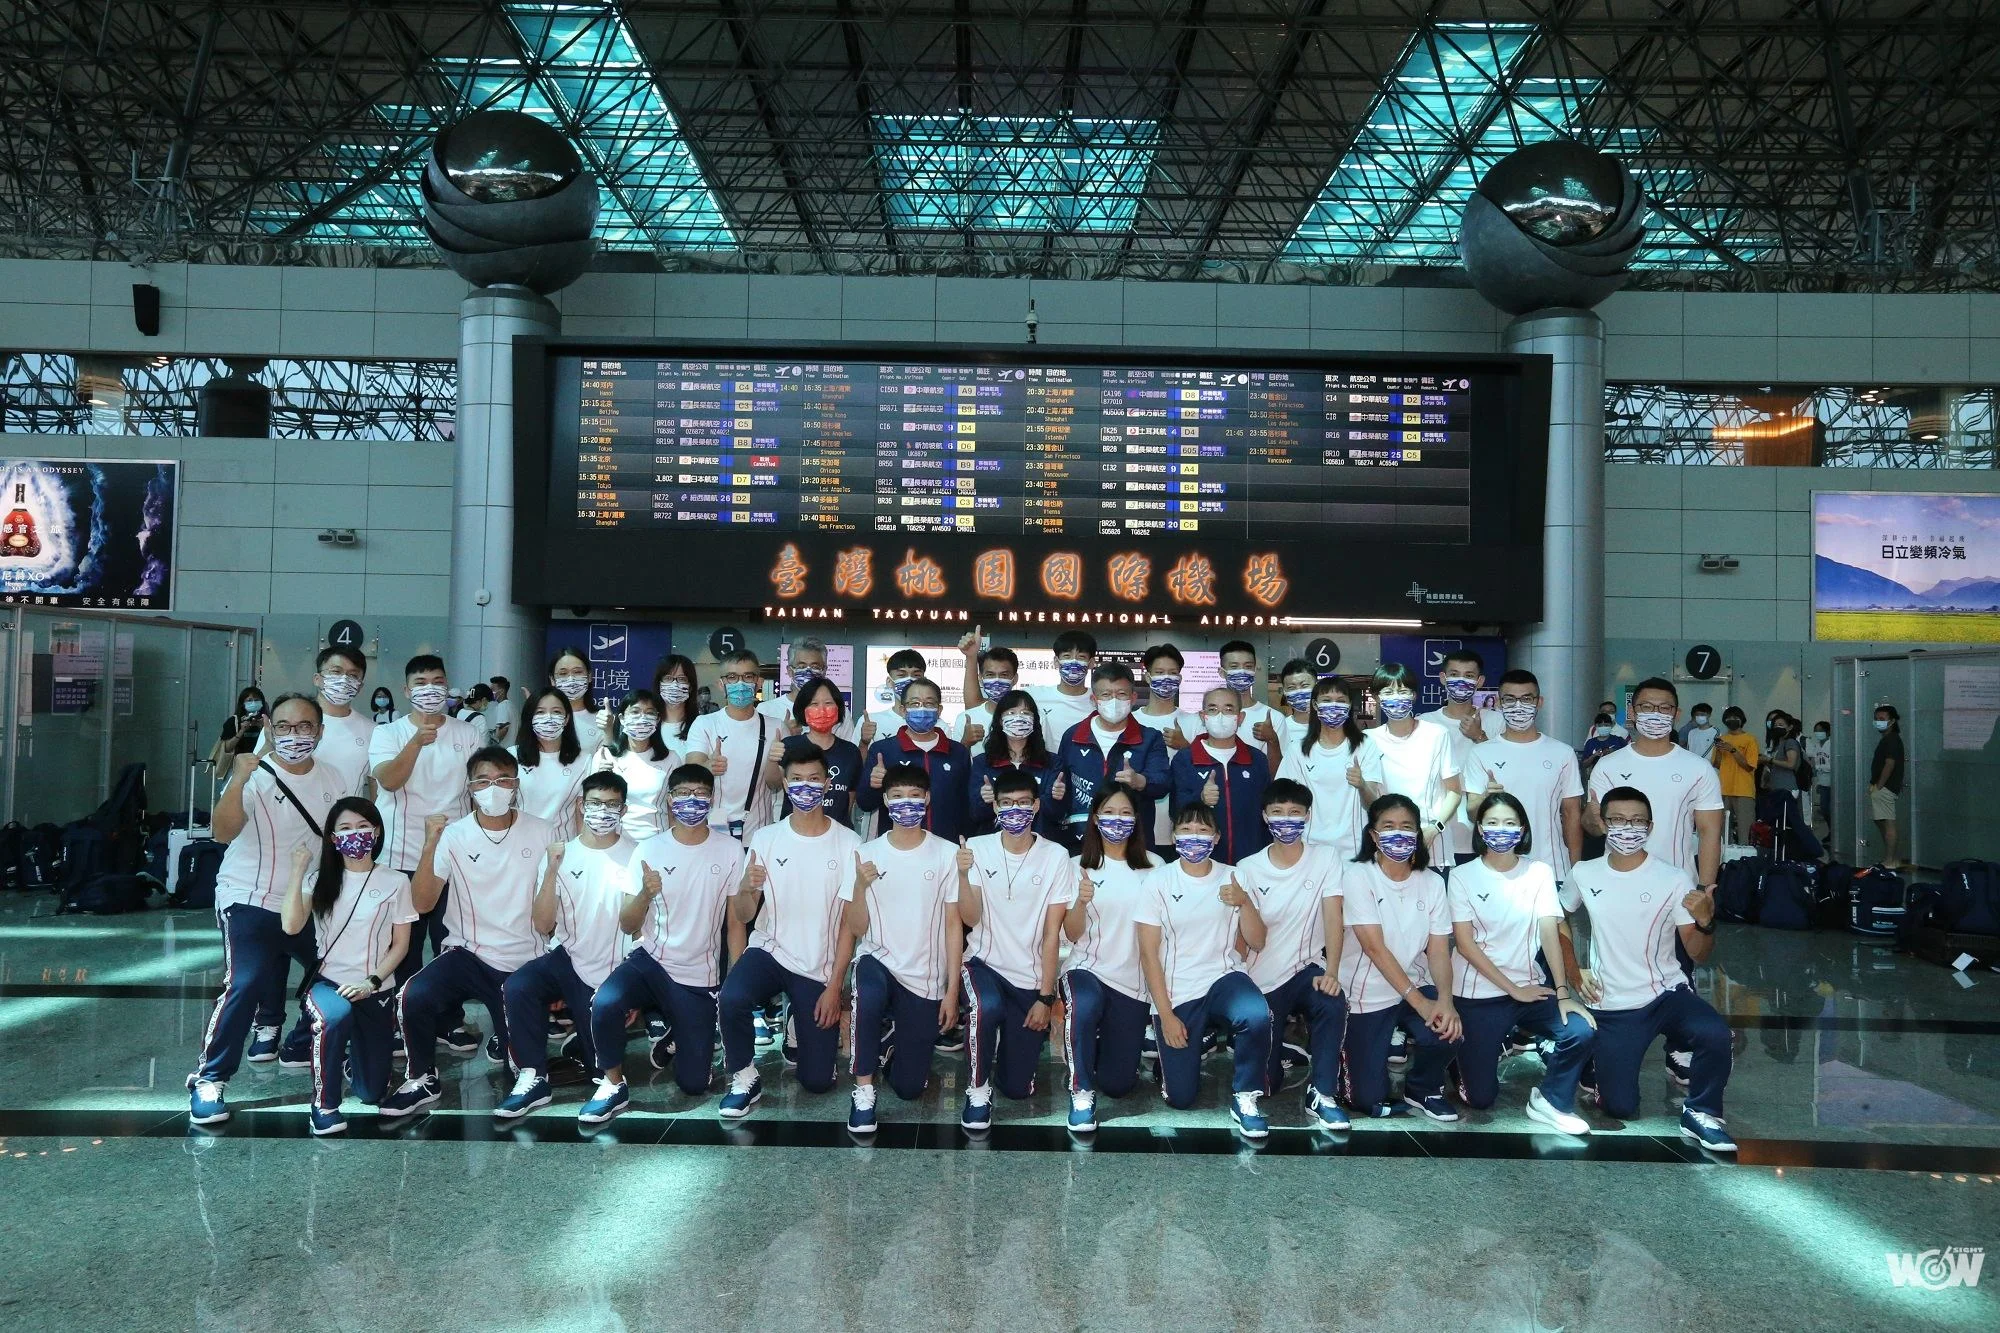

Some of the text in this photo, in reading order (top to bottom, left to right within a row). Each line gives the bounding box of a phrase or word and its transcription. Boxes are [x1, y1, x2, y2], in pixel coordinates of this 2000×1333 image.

[1882, 545, 1966, 560] 日立變頻冷氣
[770, 544, 1289, 606] 臺灣桃園國際機場
[765, 606, 1293, 626] TAIWAN TAOYUAN INTERNATIONAL AIRPORT
[336, 626, 352, 644] 4
[720, 634, 734, 654] 5
[927, 658, 966, 668] 桃園國
[1316, 644, 1330, 666] 6
[1697, 652, 1710, 672] 7
[592, 668, 630, 691] 出境
